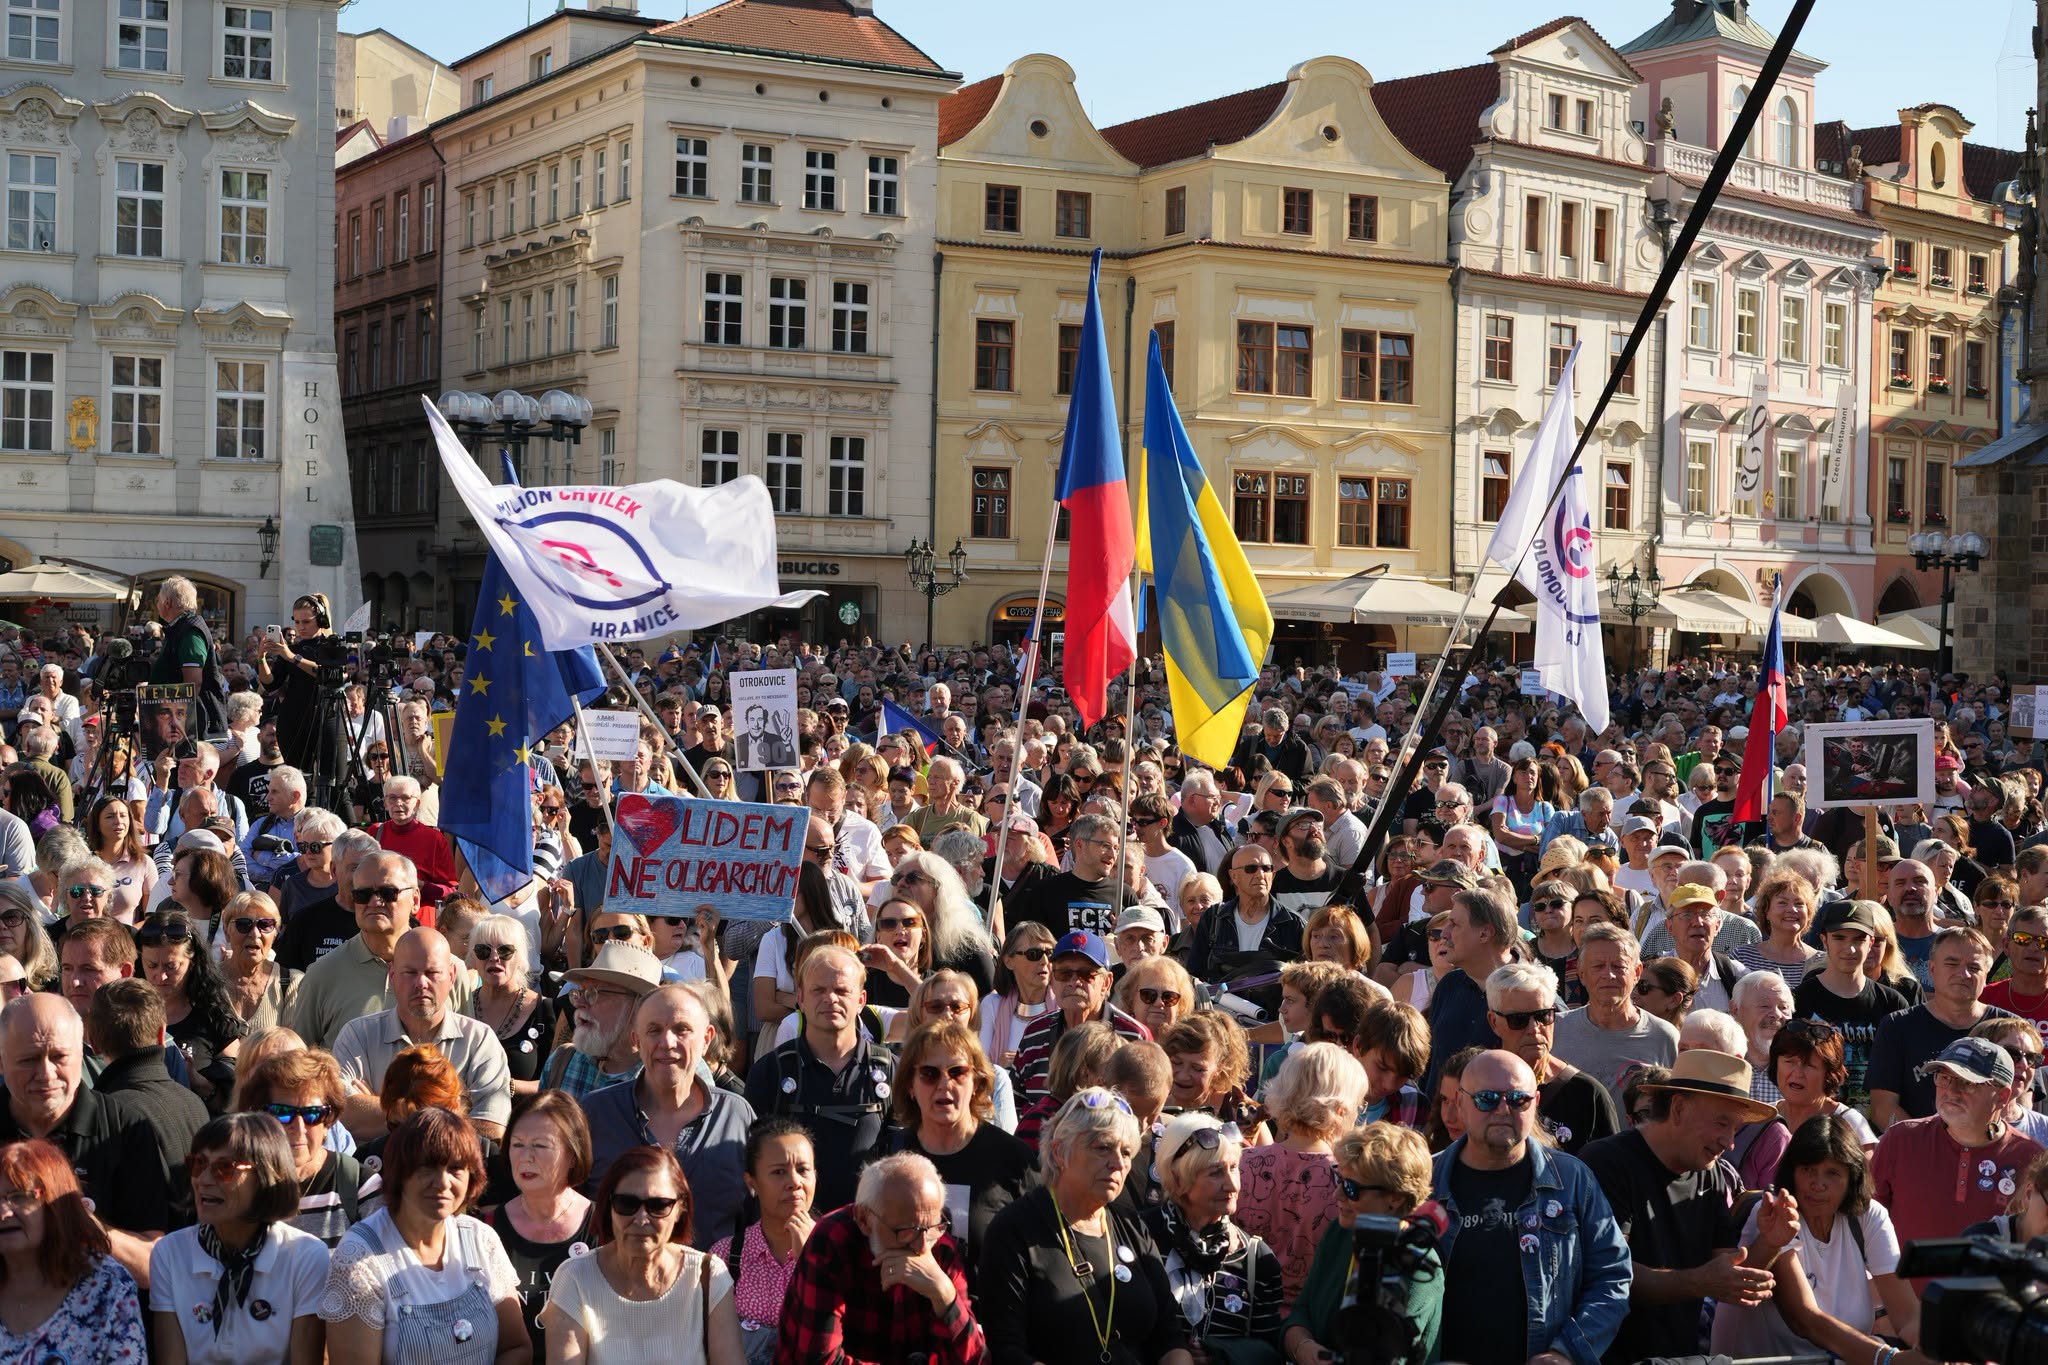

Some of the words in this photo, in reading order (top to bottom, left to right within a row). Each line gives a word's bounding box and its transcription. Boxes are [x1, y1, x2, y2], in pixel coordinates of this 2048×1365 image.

[303, 381, 320, 503] HOTEL
[1835, 407, 1849, 455] Restaurant
[1831, 456, 1841, 484] Czech
[1532, 538, 1567, 611] OLOMOU
[590, 603, 680, 639] HRANICE
[1009, 607, 1035, 616] GYROS
[138, 685, 194, 700] NELŽU
[739, 675, 786, 688] OTROKOVICE
[757, 741, 788, 765] 90
[680, 807, 794, 852] LIDEM
[665, 859, 801, 900] OLIGARCHŮM
[1067, 907, 1112, 929] FCK
[1459, 1214, 1480, 1229] 89
